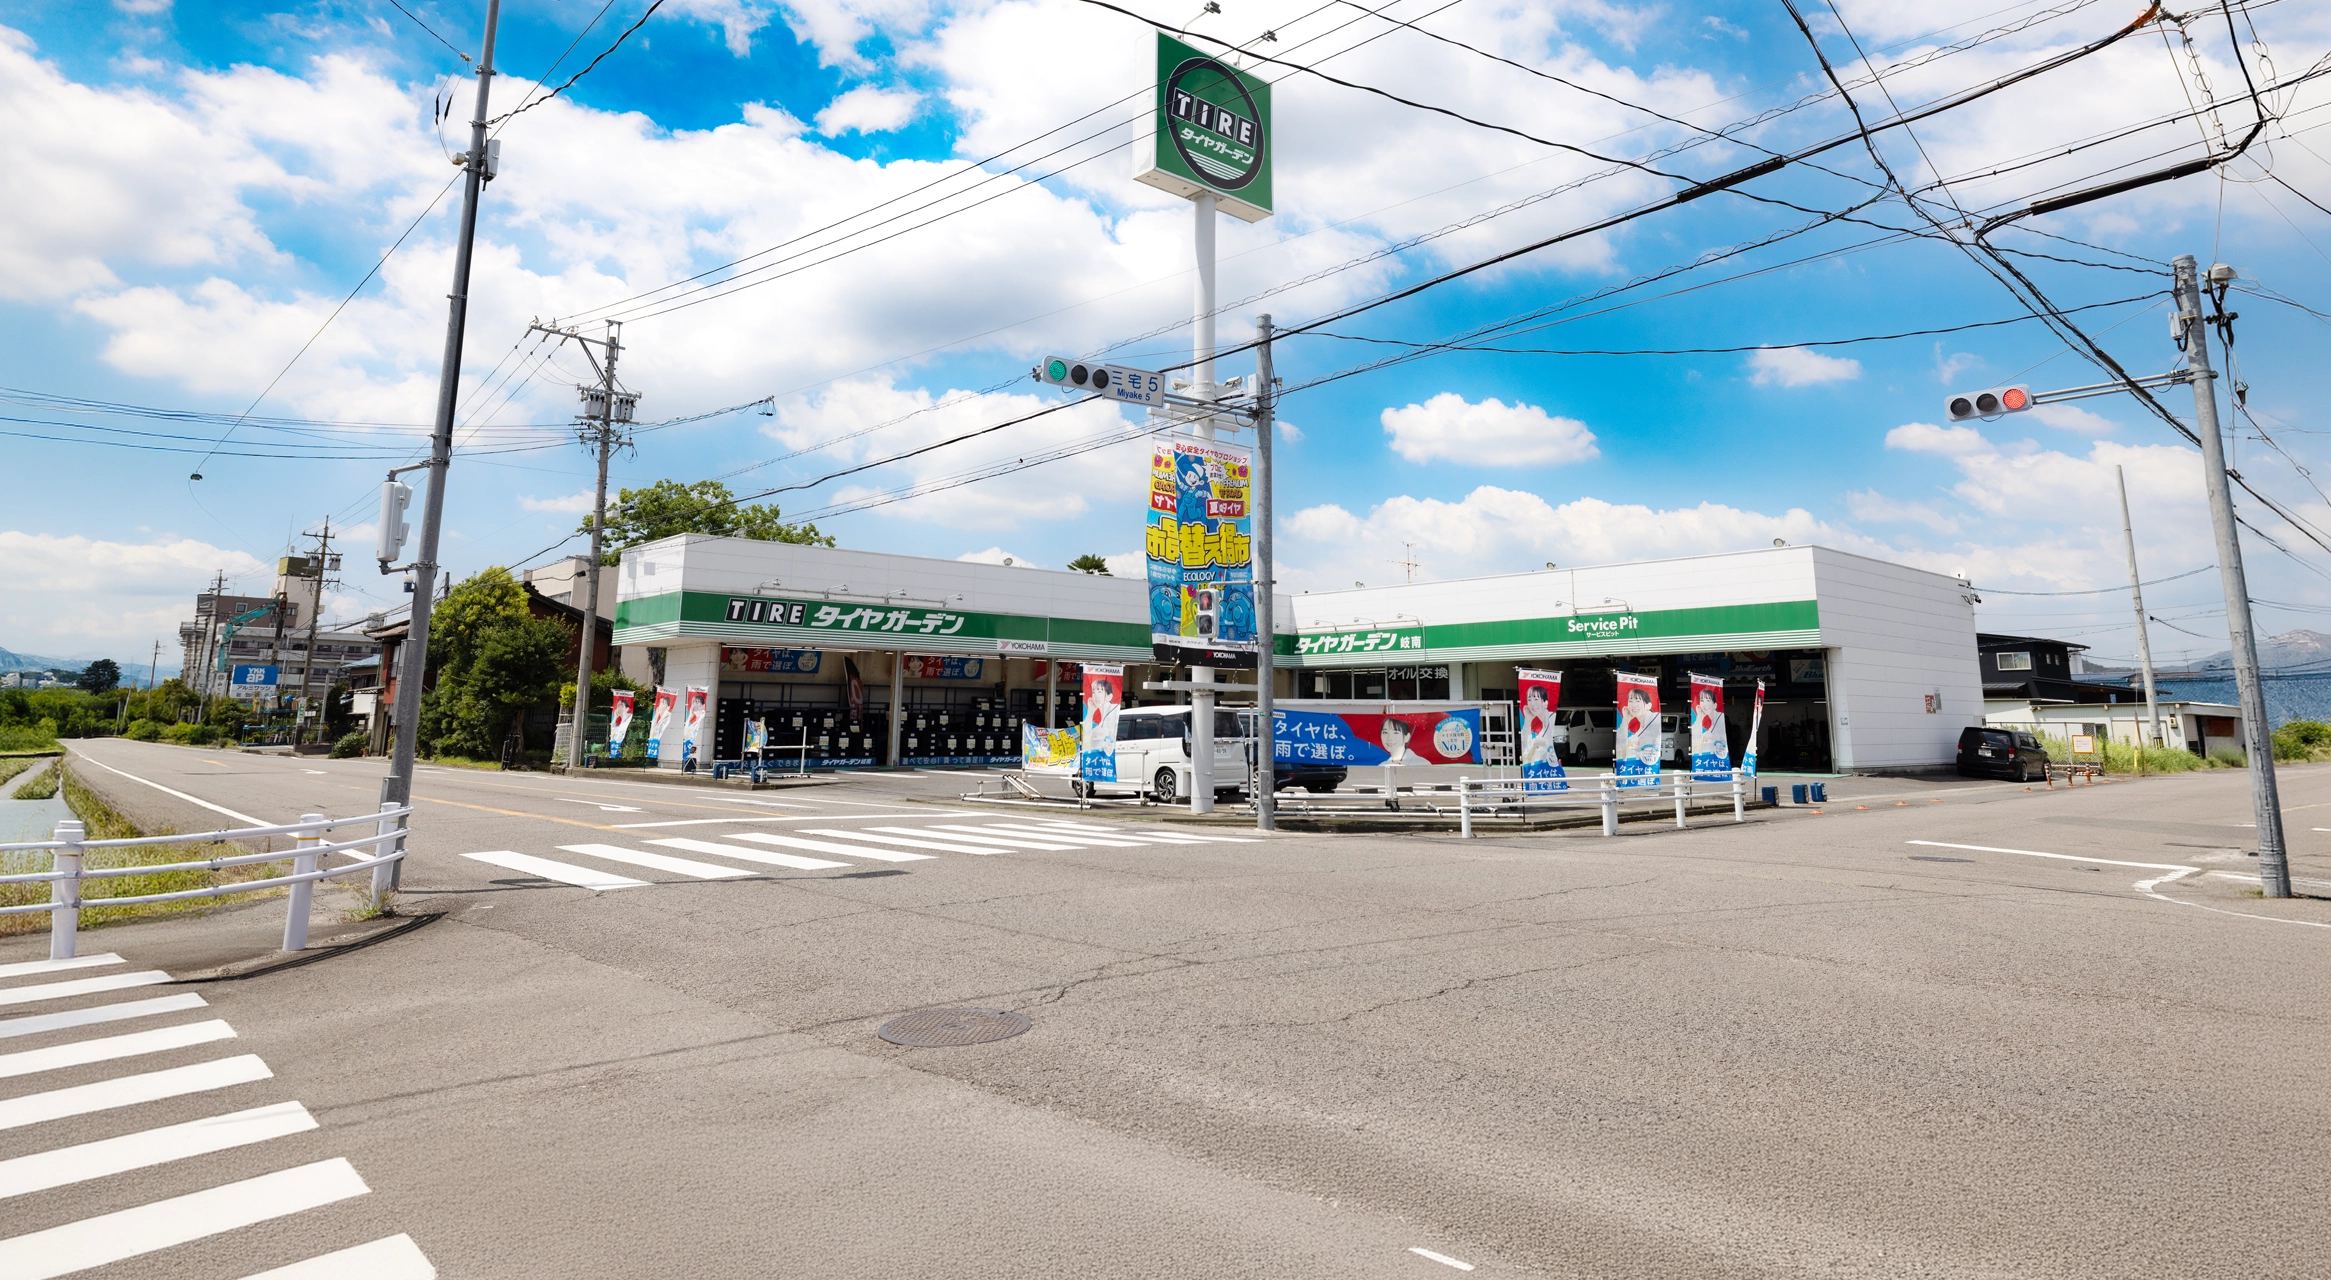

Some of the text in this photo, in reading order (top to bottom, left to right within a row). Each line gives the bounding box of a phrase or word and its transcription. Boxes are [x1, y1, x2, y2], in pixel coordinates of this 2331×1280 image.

[1175, 91, 1253, 146] TIRE
[1180, 127, 1254, 165] タイヤガーデン
[1111, 370, 1158, 392] 三宅 5
[1117, 388, 1151, 401] Miyake 5
[1183, 571, 1215, 582] ECOLOGY
[730, 600, 804, 624] TIRE
[810, 605, 965, 634] タイヤガーデン
[1567, 615, 1639, 633] Service Pit
[1011, 642, 1046, 651] YOKOHAMA
[1294, 632, 1422, 654] タイヤガーデン 岐南
[1530, 673, 1558, 681] YOKOHAMA
[1275, 719, 1347, 741] タイヤは、
[1275, 740, 1355, 761] 雨で選ぼ。
[1441, 739, 1465, 752] No.1
[821, 758, 861, 766] タイヤガーデン
[1619, 764, 1656, 775] タイヤは、
[1695, 758, 1729, 769] タイヤは、
[1528, 768, 1562, 779] タイヤは、
